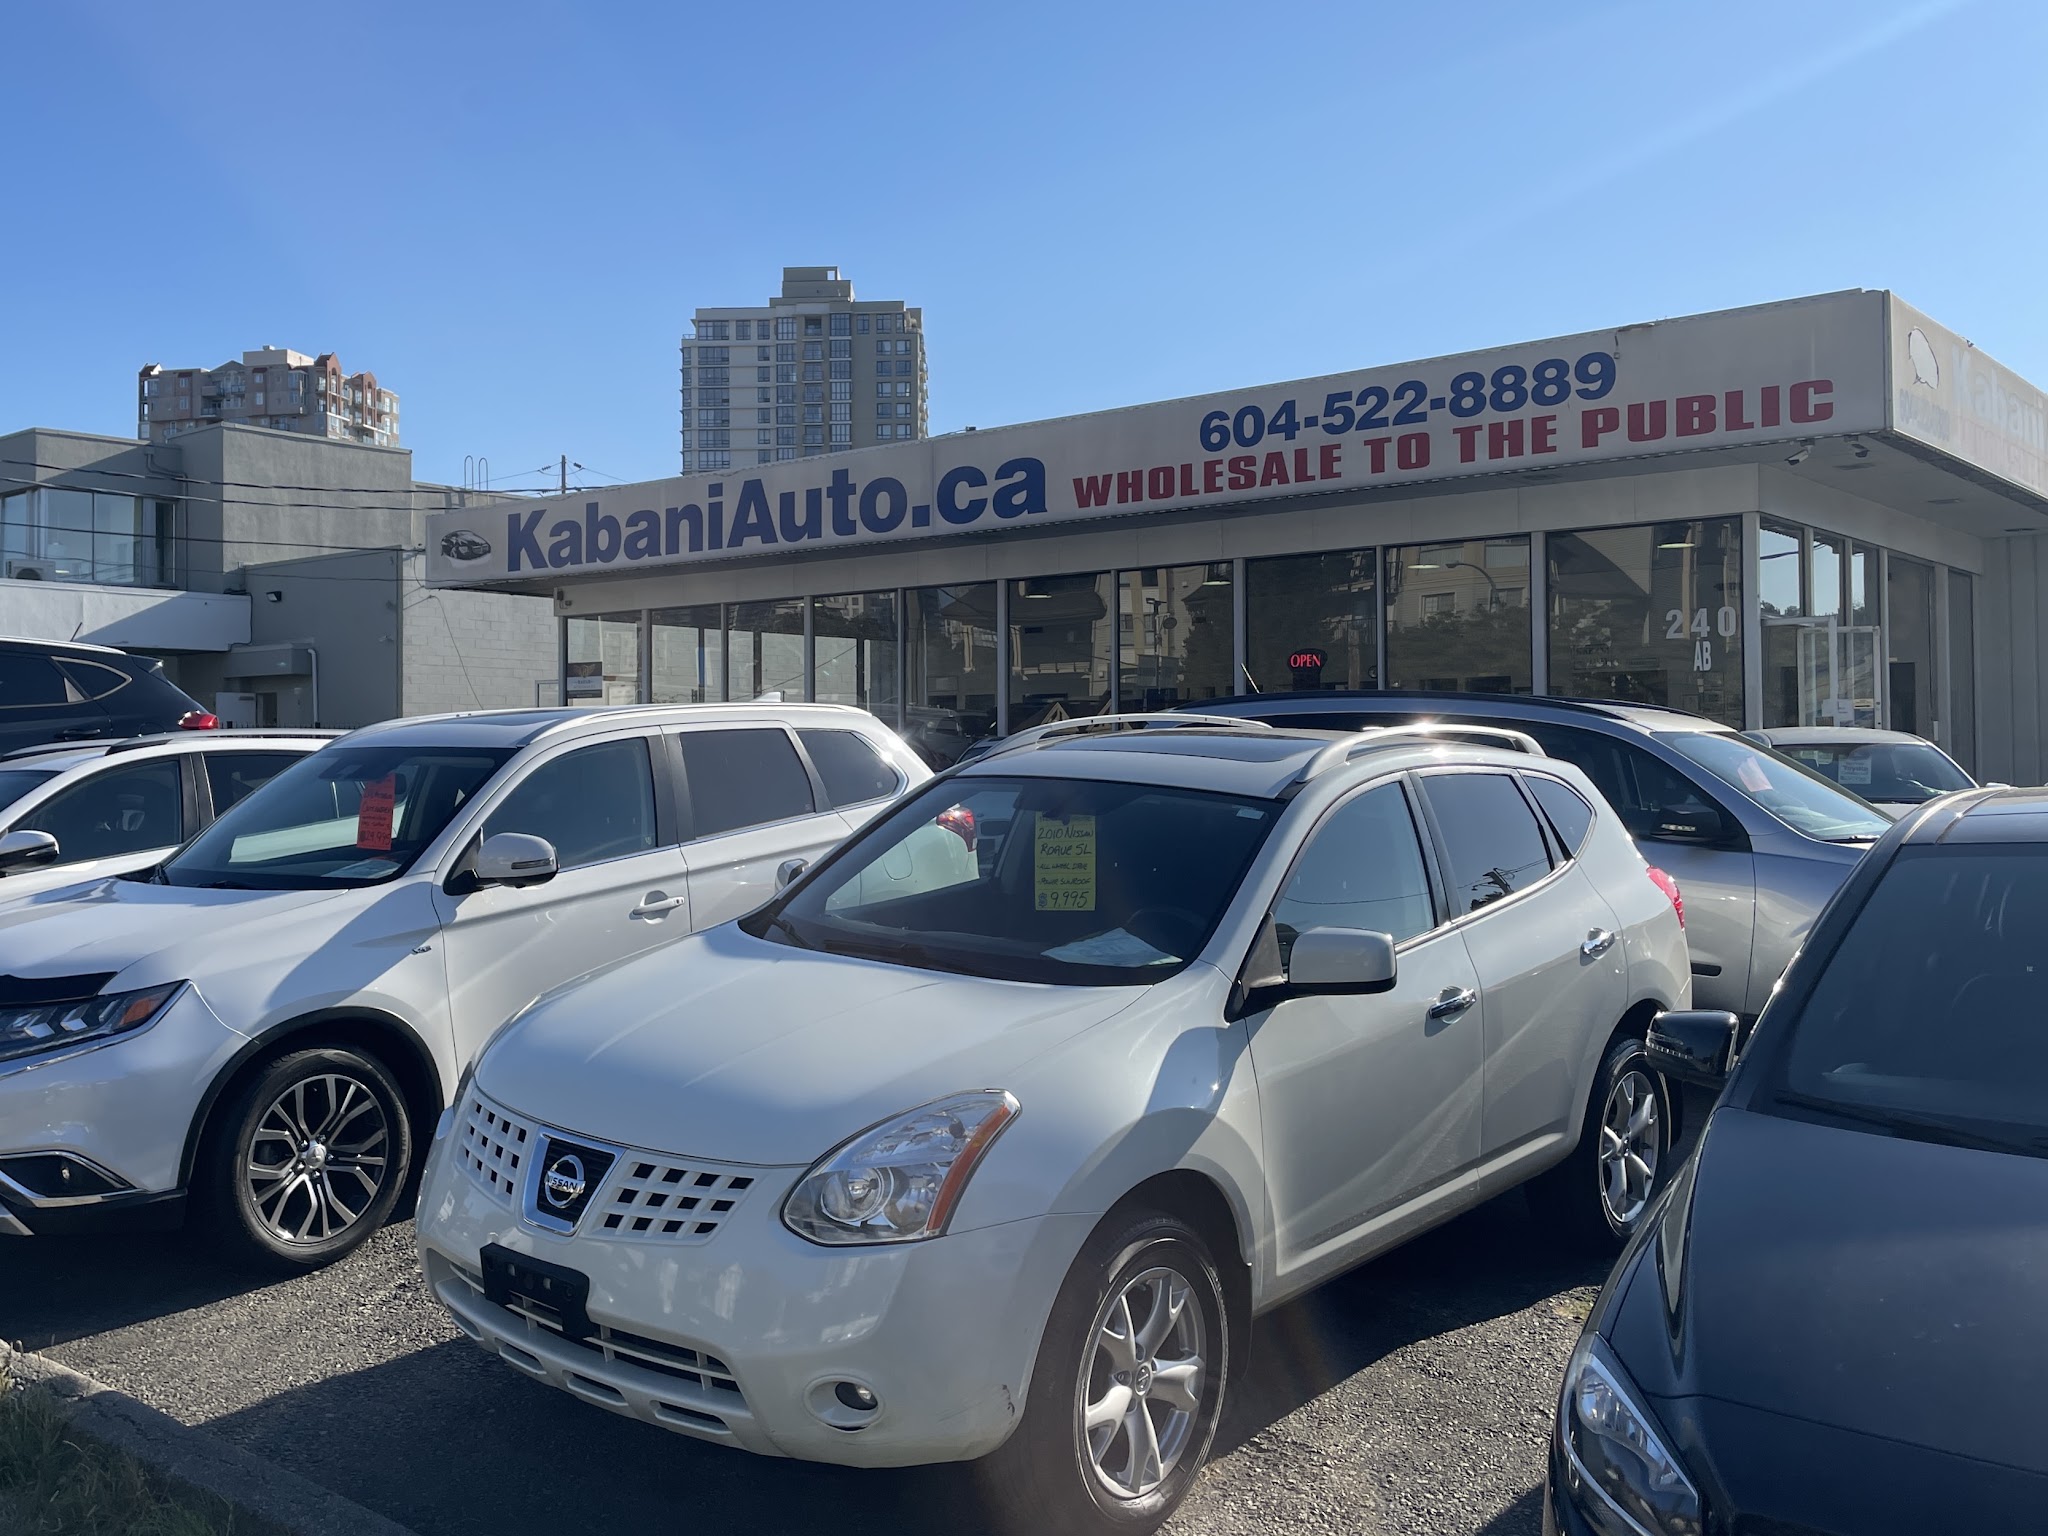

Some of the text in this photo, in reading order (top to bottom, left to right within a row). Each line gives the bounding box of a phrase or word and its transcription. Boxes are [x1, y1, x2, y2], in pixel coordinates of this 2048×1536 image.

[1200, 351, 1616, 452] 604-522-8889
[1073, 443, 1342, 509] WHOLESALE
[1363, 432, 1430, 474] TO
[1452, 414, 1557, 463] THE
[1581, 379, 1834, 448] PUBLIC
[507, 457, 1047, 572] KabaniAuto.ca
[1665, 606, 1737, 639] 240
[1290, 653, 1321, 668] OPEN
[1693, 640, 1712, 672] AB
[1037, 827, 1063, 840] 2010
[1075, 843, 1092, 856] SL
